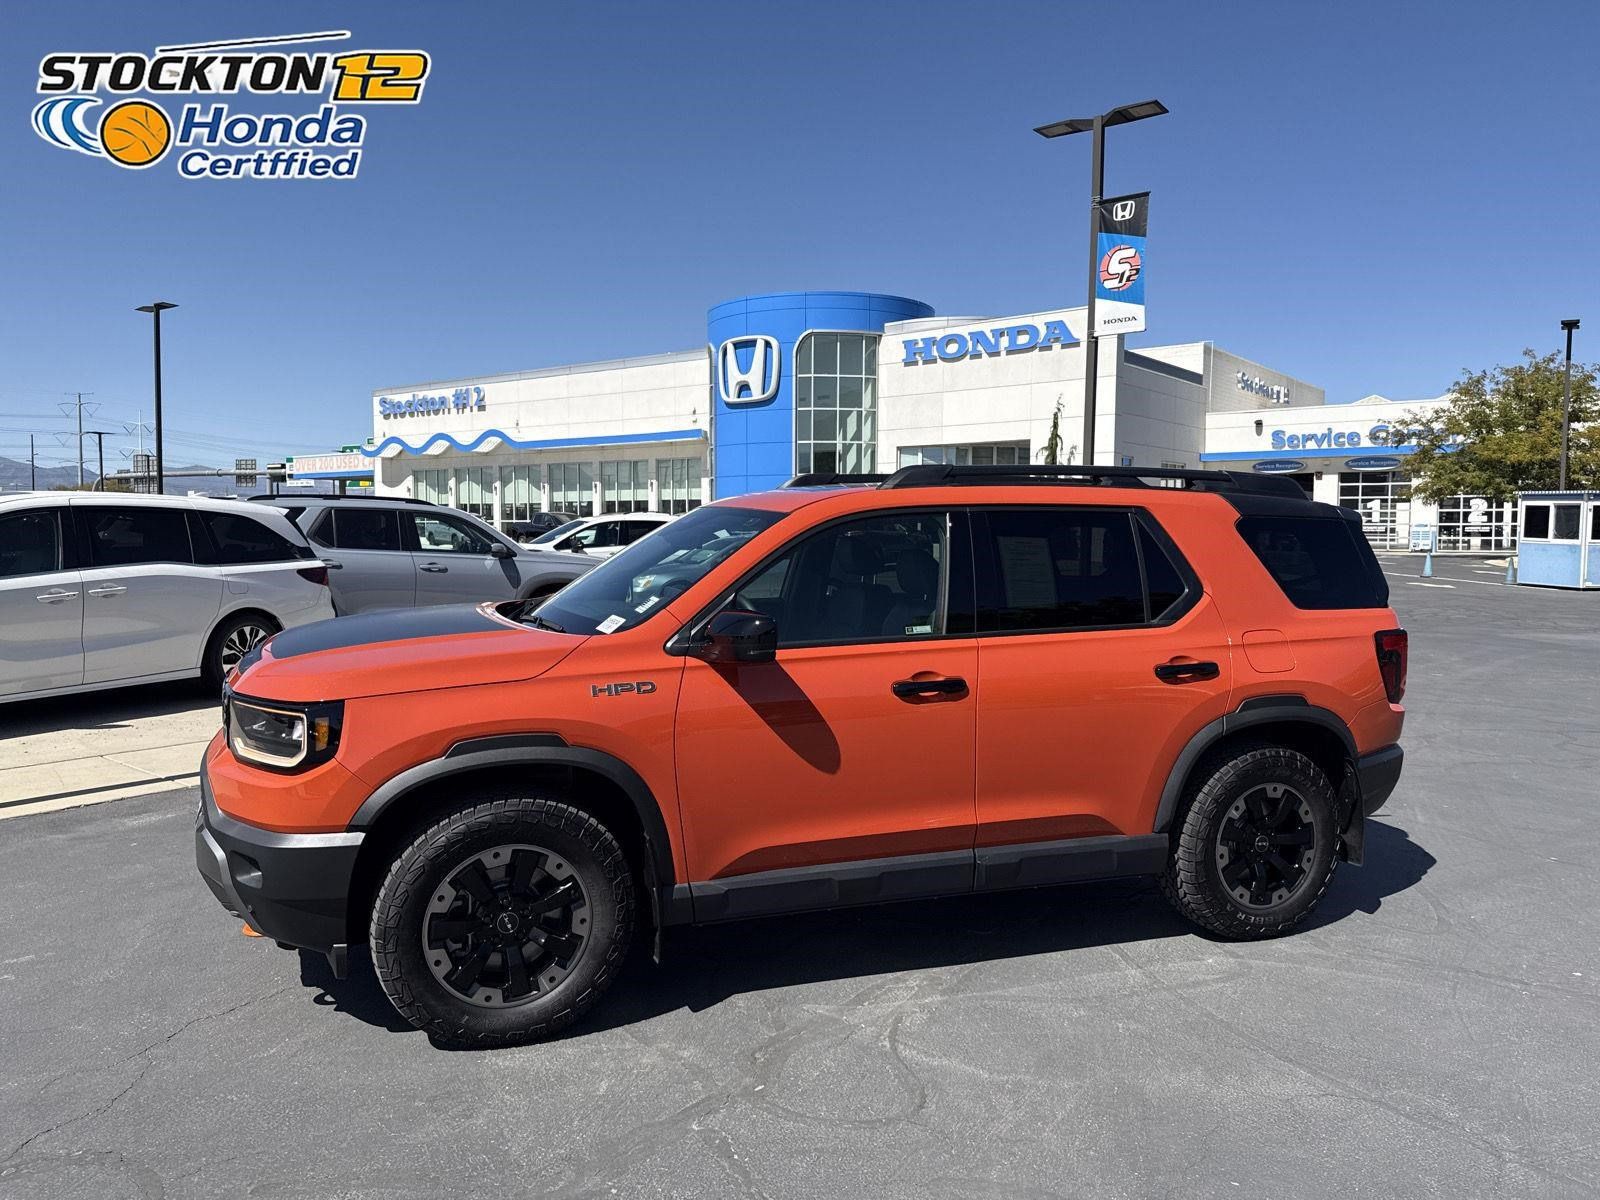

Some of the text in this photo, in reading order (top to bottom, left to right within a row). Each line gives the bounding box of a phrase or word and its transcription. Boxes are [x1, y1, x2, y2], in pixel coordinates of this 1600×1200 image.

[1103, 316, 1138, 325] HONDA
[901, 319, 1080, 364] HONDA
[379, 386, 486, 417] Stockton #12
[1271, 427, 1361, 449] Service
[295, 460, 317, 472] OVER
[319, 458, 335, 471] 200
[336, 455, 360, 468] USED
[1366, 499, 1381, 523] 1
[1467, 498, 1488, 523] 2
[591, 681, 657, 697] HPD
